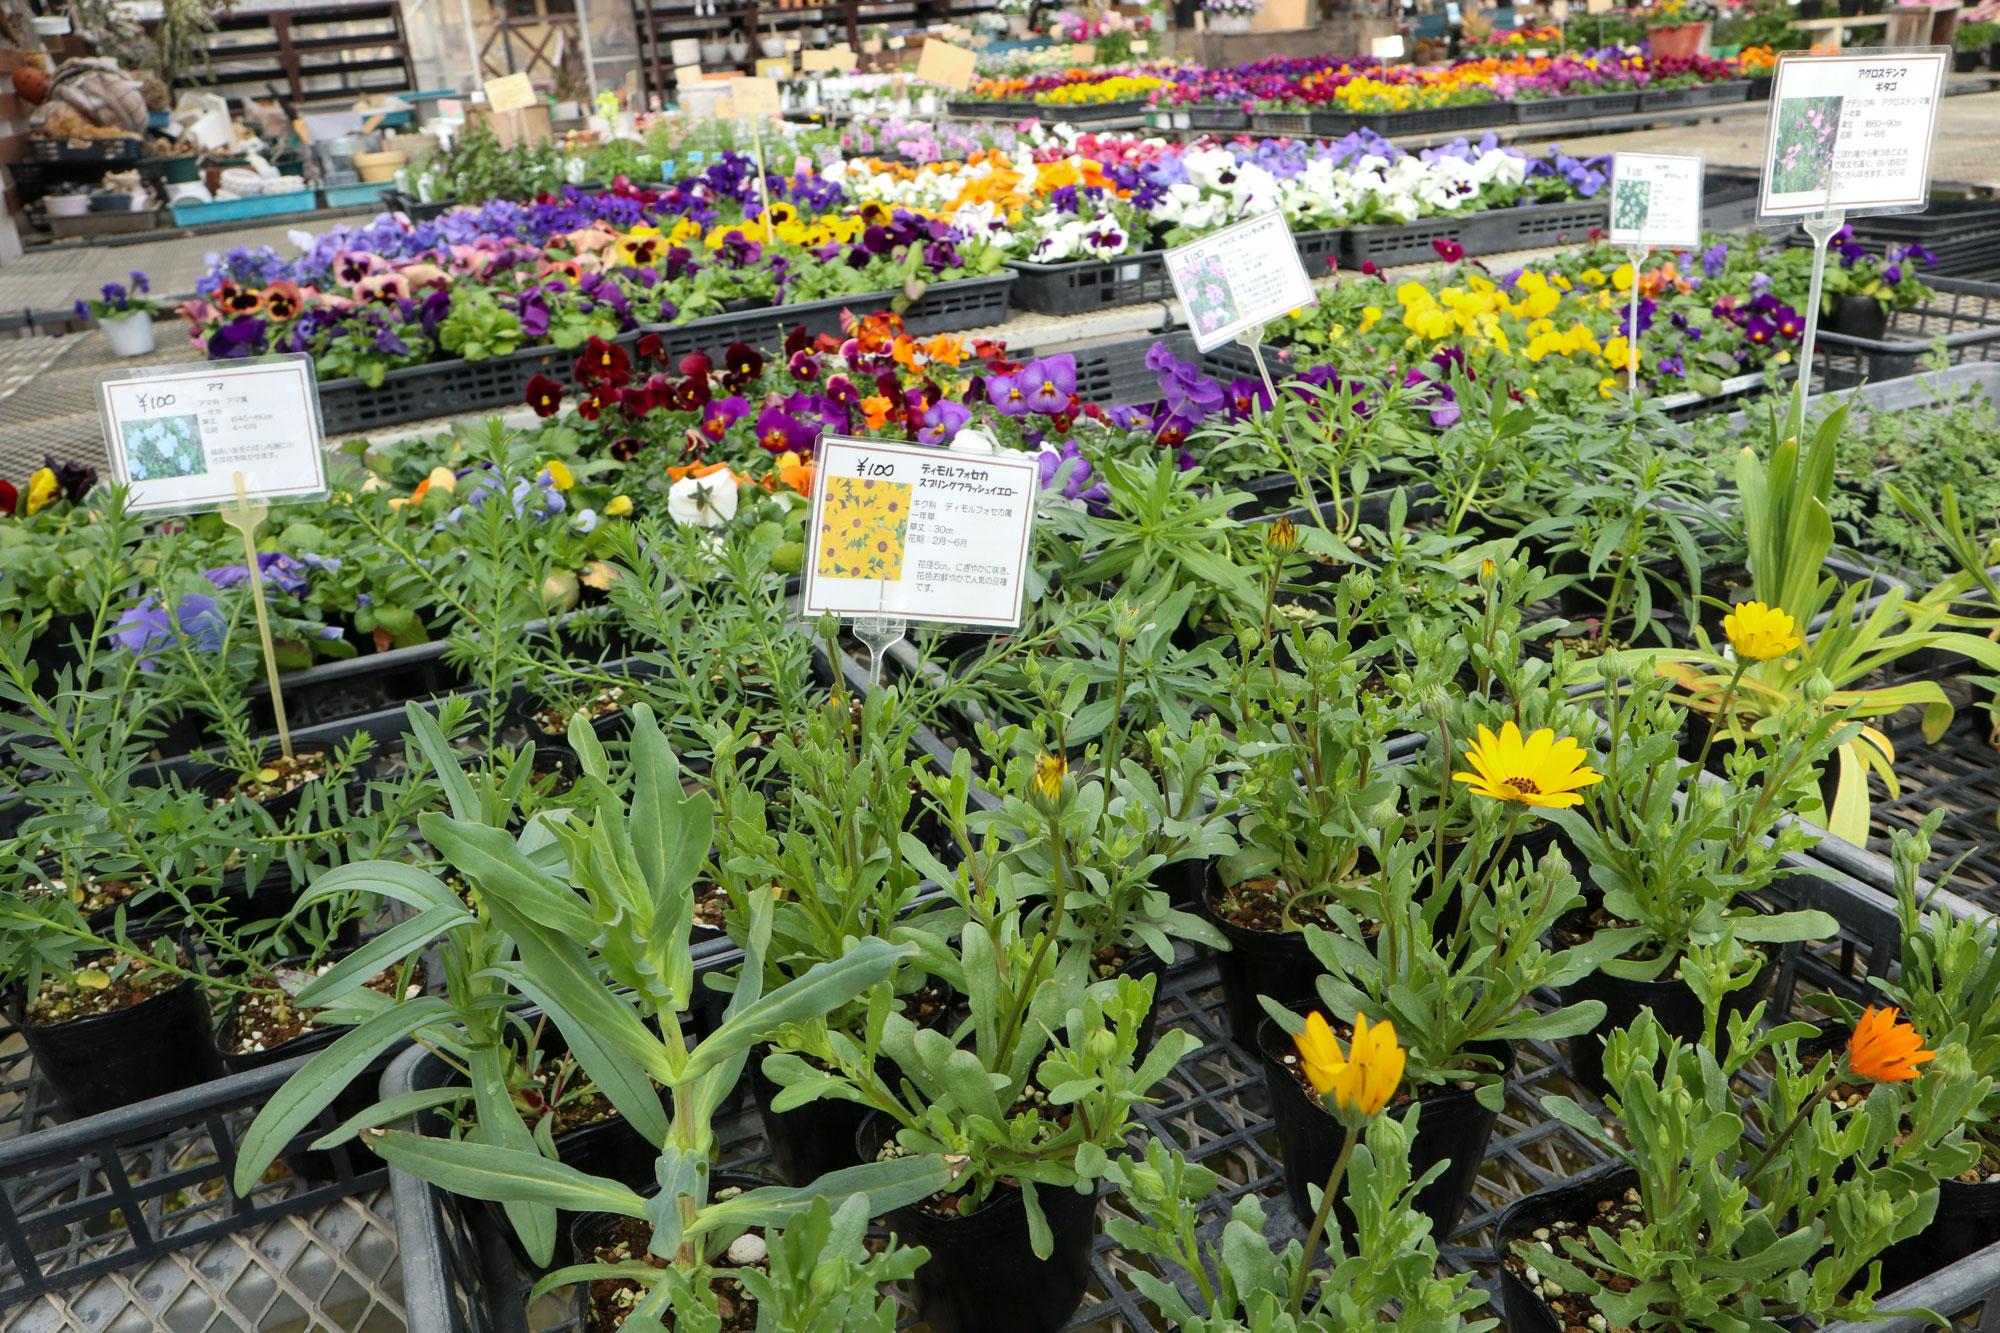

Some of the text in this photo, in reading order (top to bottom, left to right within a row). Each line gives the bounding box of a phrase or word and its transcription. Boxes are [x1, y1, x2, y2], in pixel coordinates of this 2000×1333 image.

[1858, 67, 1908, 79] アグロステンマ
[1875, 81, 1898, 92] ギタゴ
[206, 382, 224, 393] アマ
[135, 393, 176, 413] ¥100
[856, 456, 895, 477] ¥100
[921, 463, 989, 482] ディモルフォセカ
[919, 478, 1019, 497] スプリングフラッシュイエロー
[911, 511, 935, 520] 一年草
[913, 499, 1013, 517] キク科 ディモルフォセカ属
